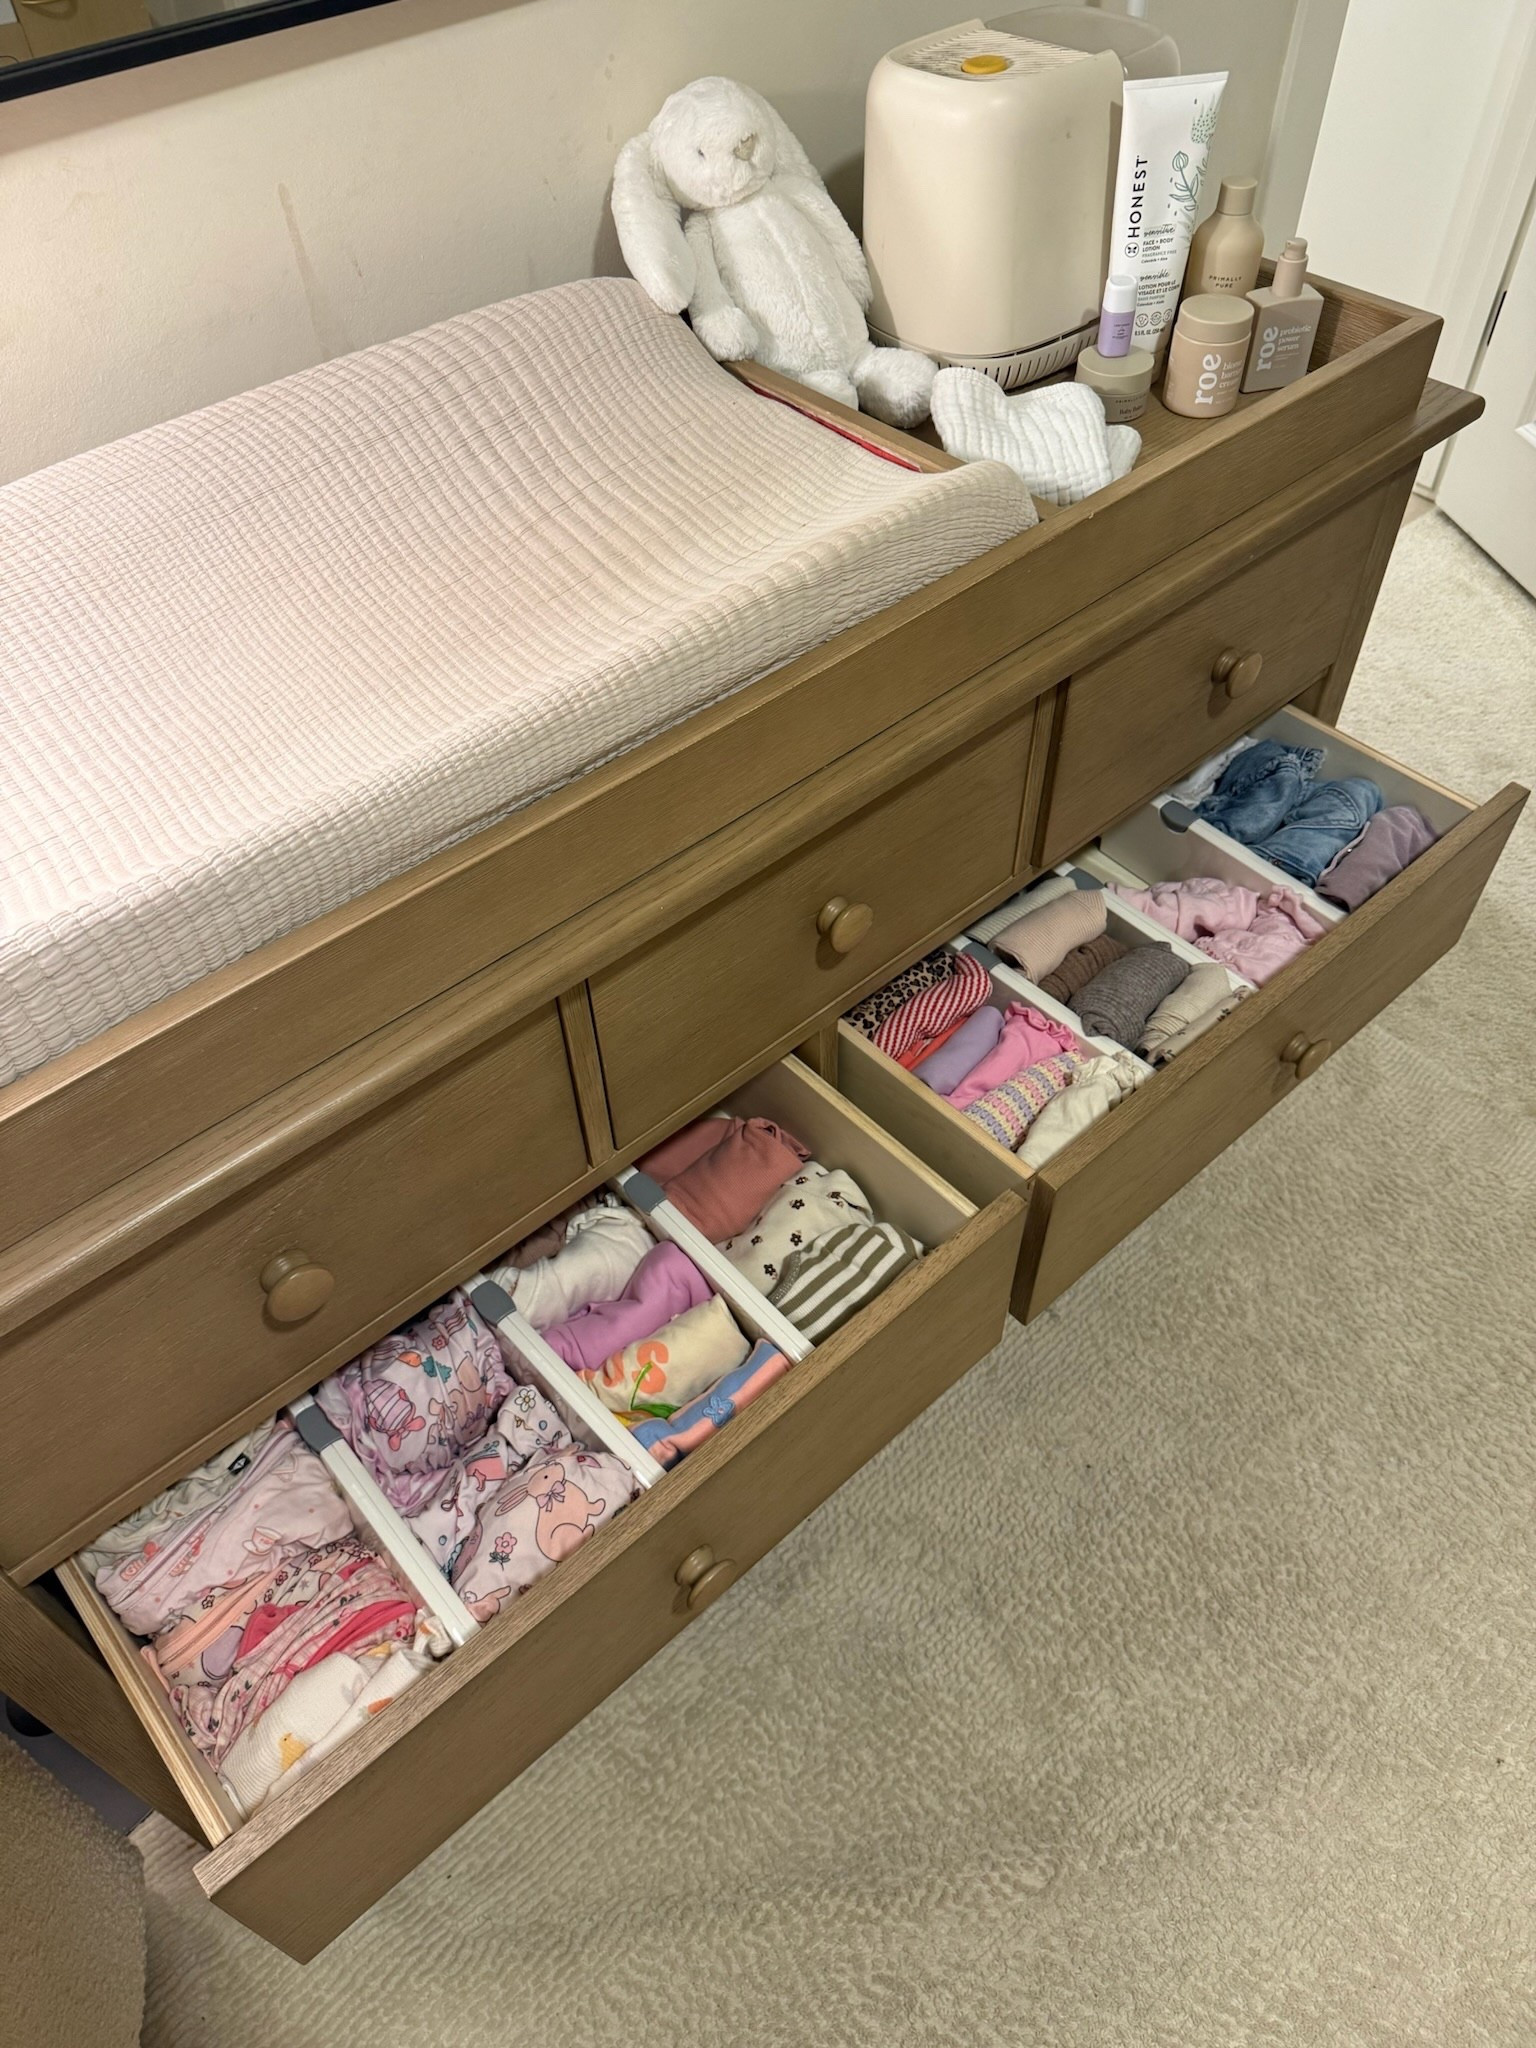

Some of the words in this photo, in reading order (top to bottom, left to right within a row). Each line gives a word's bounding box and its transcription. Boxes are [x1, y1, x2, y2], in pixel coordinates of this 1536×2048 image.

[1127, 158, 1148, 238] HONEST
[1140, 269, 1169, 281] sensible
[1256, 326, 1279, 372] roe
[1194, 354, 1222, 405] roe
